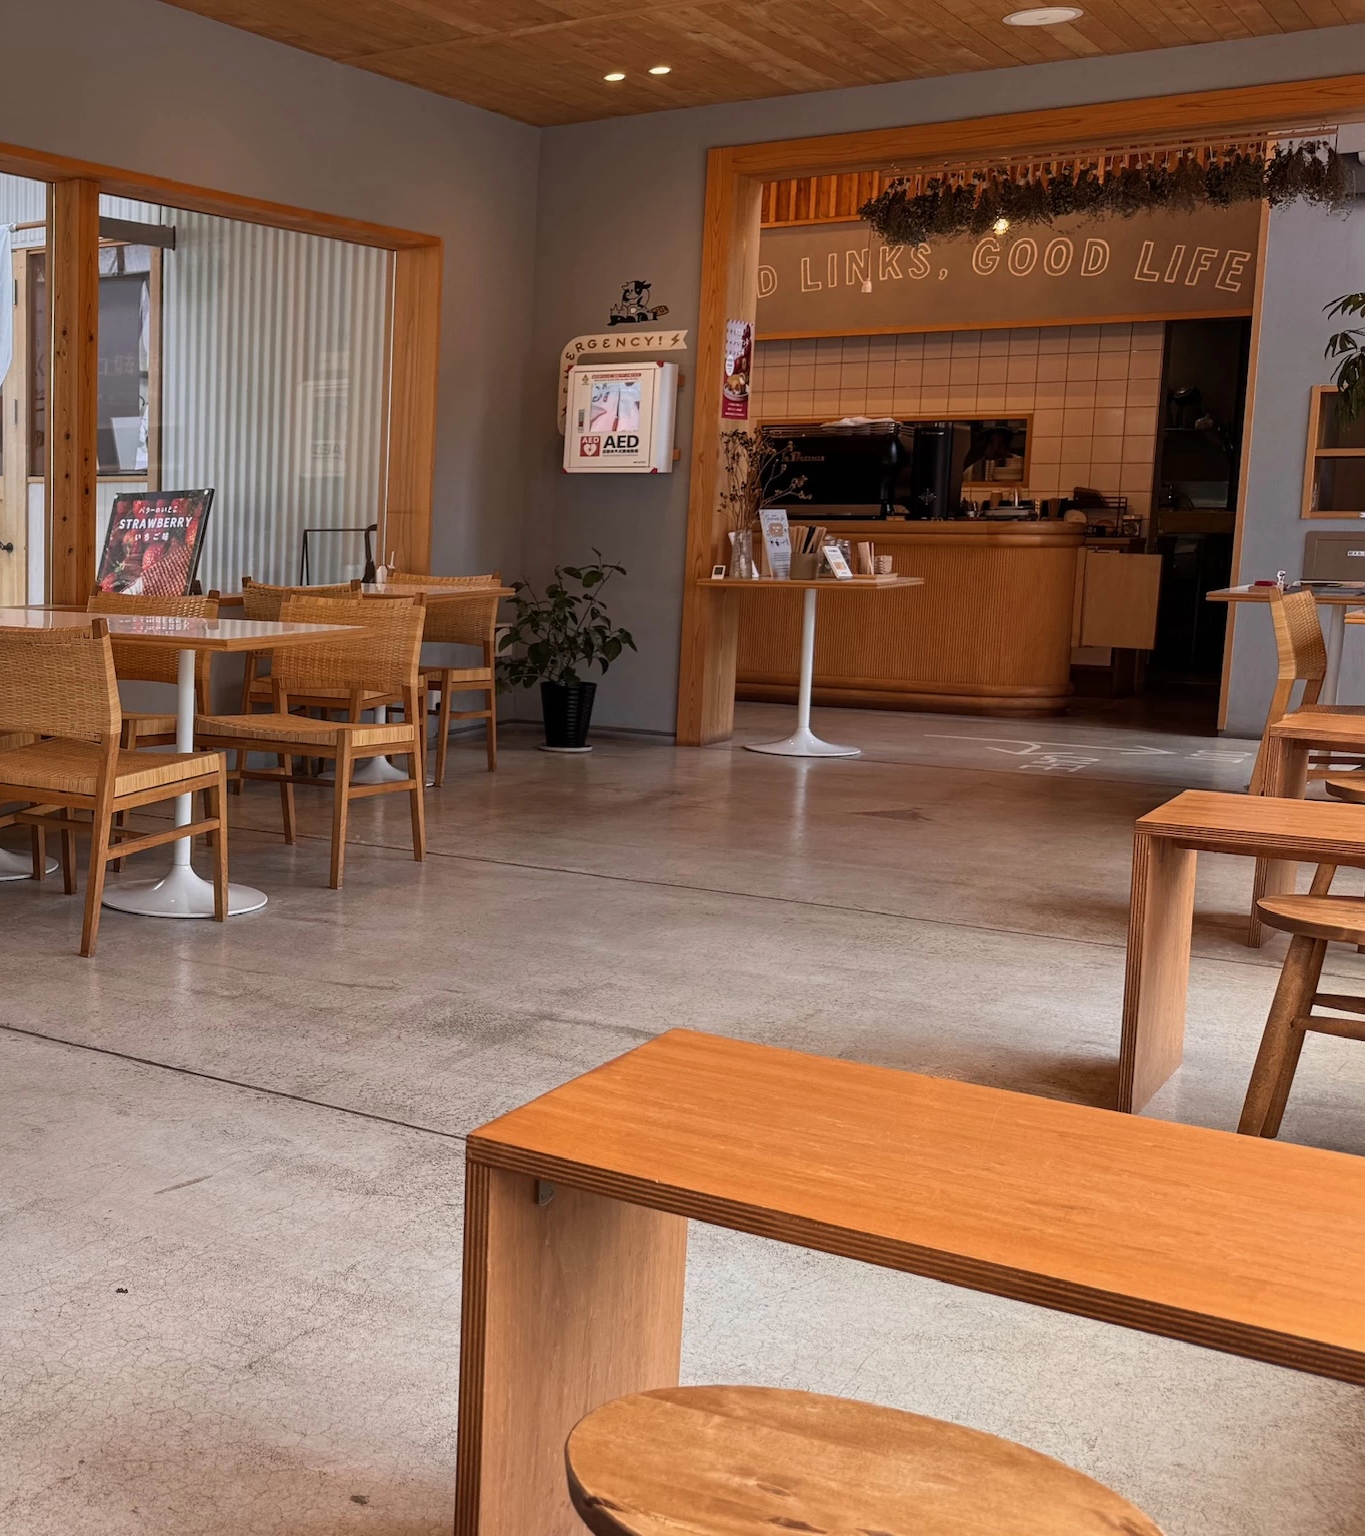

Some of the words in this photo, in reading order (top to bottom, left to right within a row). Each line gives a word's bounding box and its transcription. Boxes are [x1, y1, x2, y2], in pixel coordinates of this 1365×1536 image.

[801, 242, 949, 293] LINKS,
[972, 237, 1110, 277] GOOD
[1134, 240, 1252, 293] LIFE
[603, 435, 639, 448] AED
[118, 516, 193, 530] STRAWBERRY
[135, 532, 170, 541] いちご味
